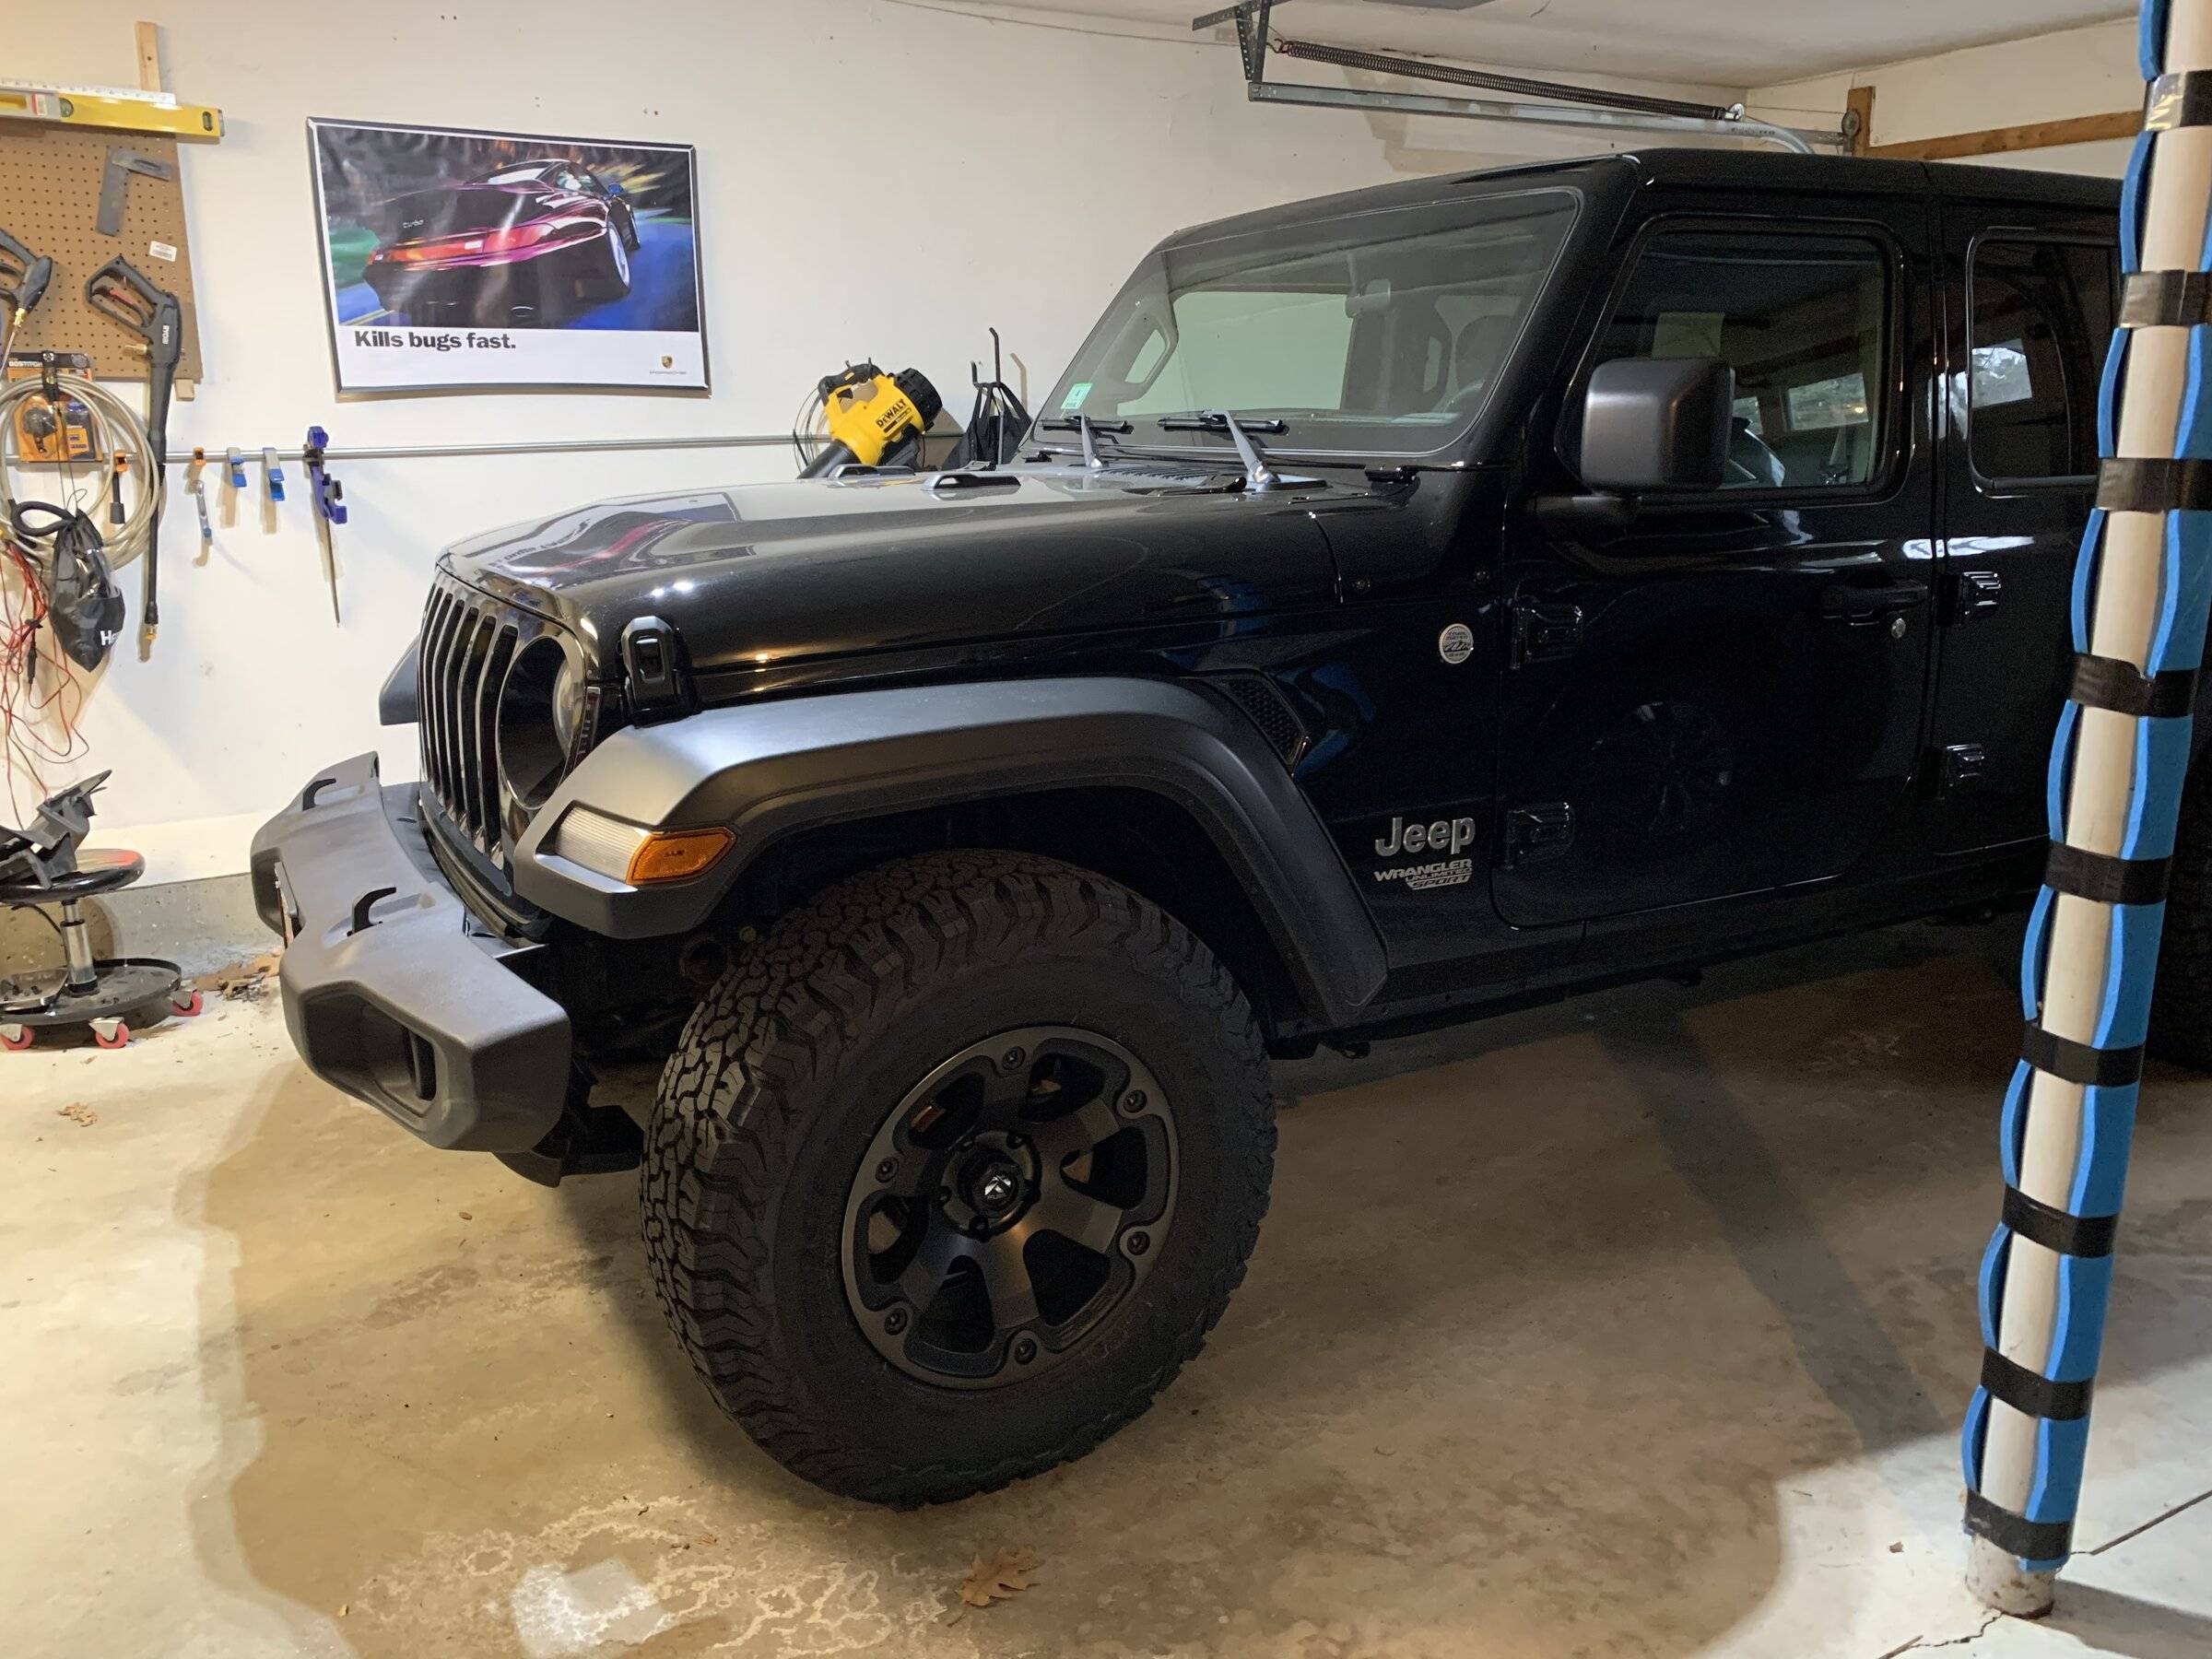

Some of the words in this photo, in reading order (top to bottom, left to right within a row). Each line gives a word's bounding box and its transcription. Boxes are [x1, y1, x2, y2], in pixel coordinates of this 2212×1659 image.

[355, 331, 403, 347] Kills
[408, 332, 462, 352] bugs
[466, 333, 516, 349] fast.
[1375, 817, 1476, 856] Jeep
[1373, 858, 1473, 882] WRANGLER
